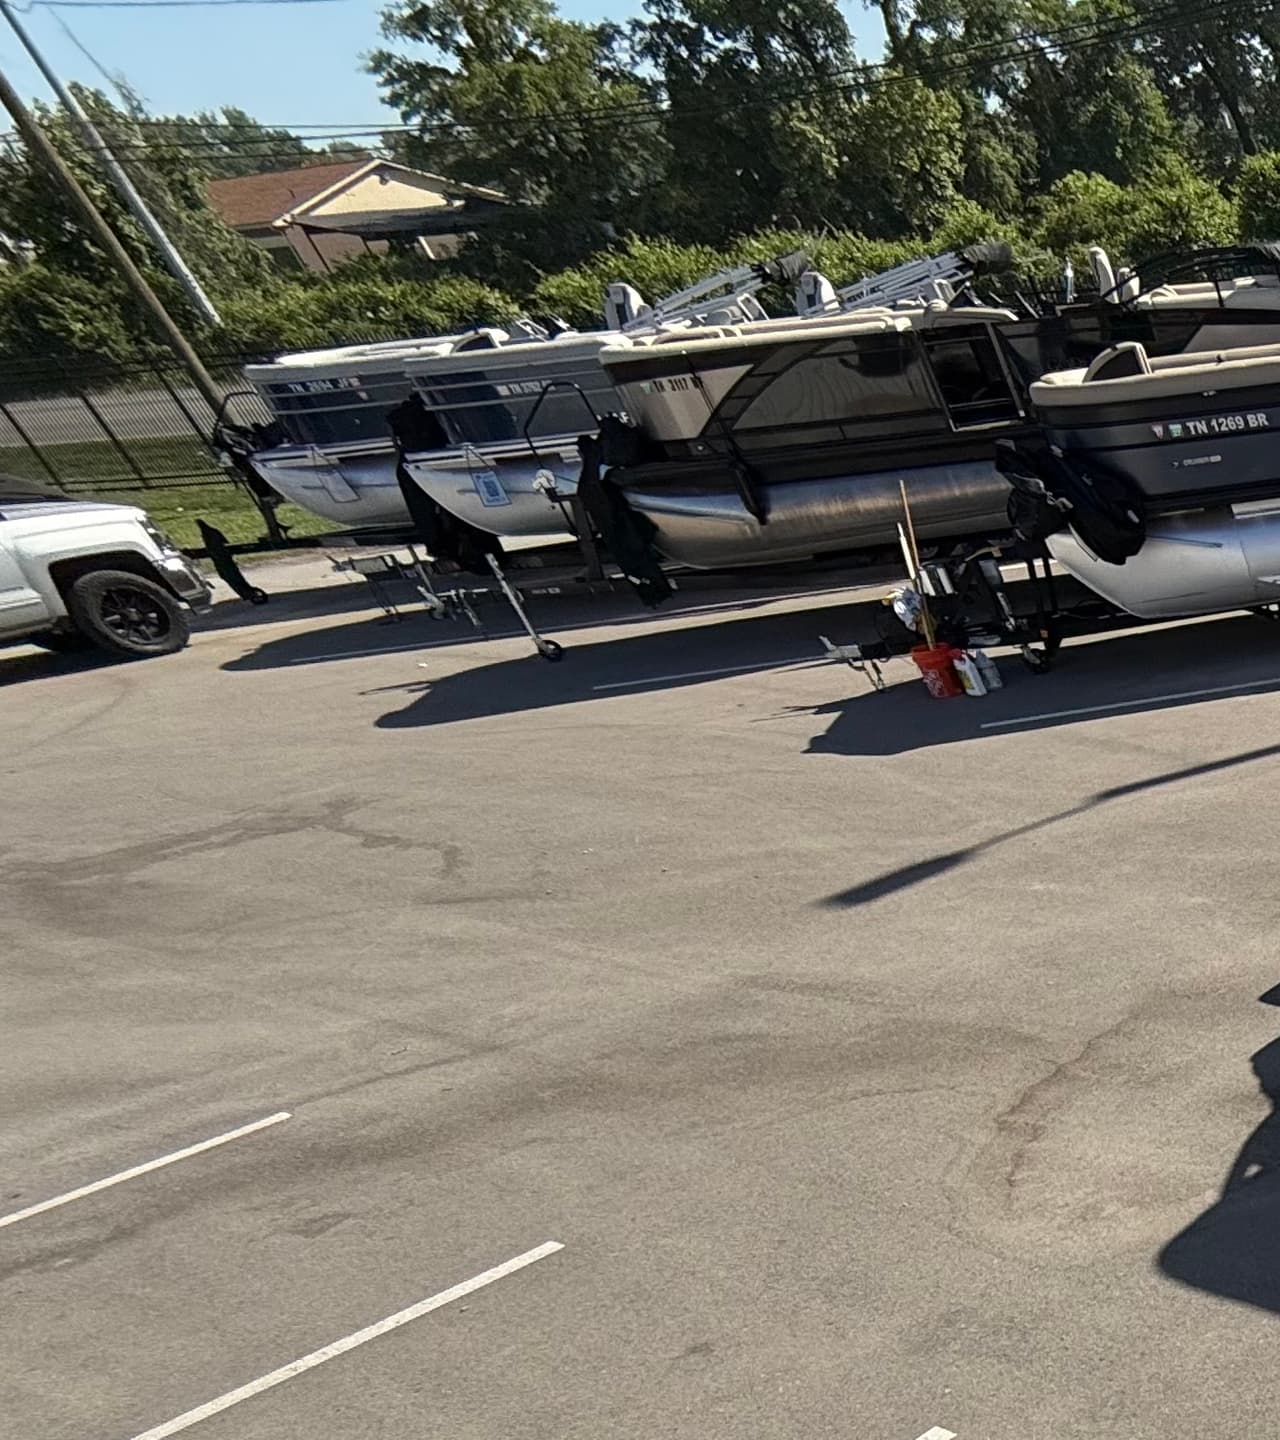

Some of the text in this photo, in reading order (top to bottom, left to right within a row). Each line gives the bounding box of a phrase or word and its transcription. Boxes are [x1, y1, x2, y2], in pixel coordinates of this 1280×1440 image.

[1185, 420, 1209, 435] TN
[1210, 415, 1245, 432] 1269
[1246, 412, 1269, 428] BR
